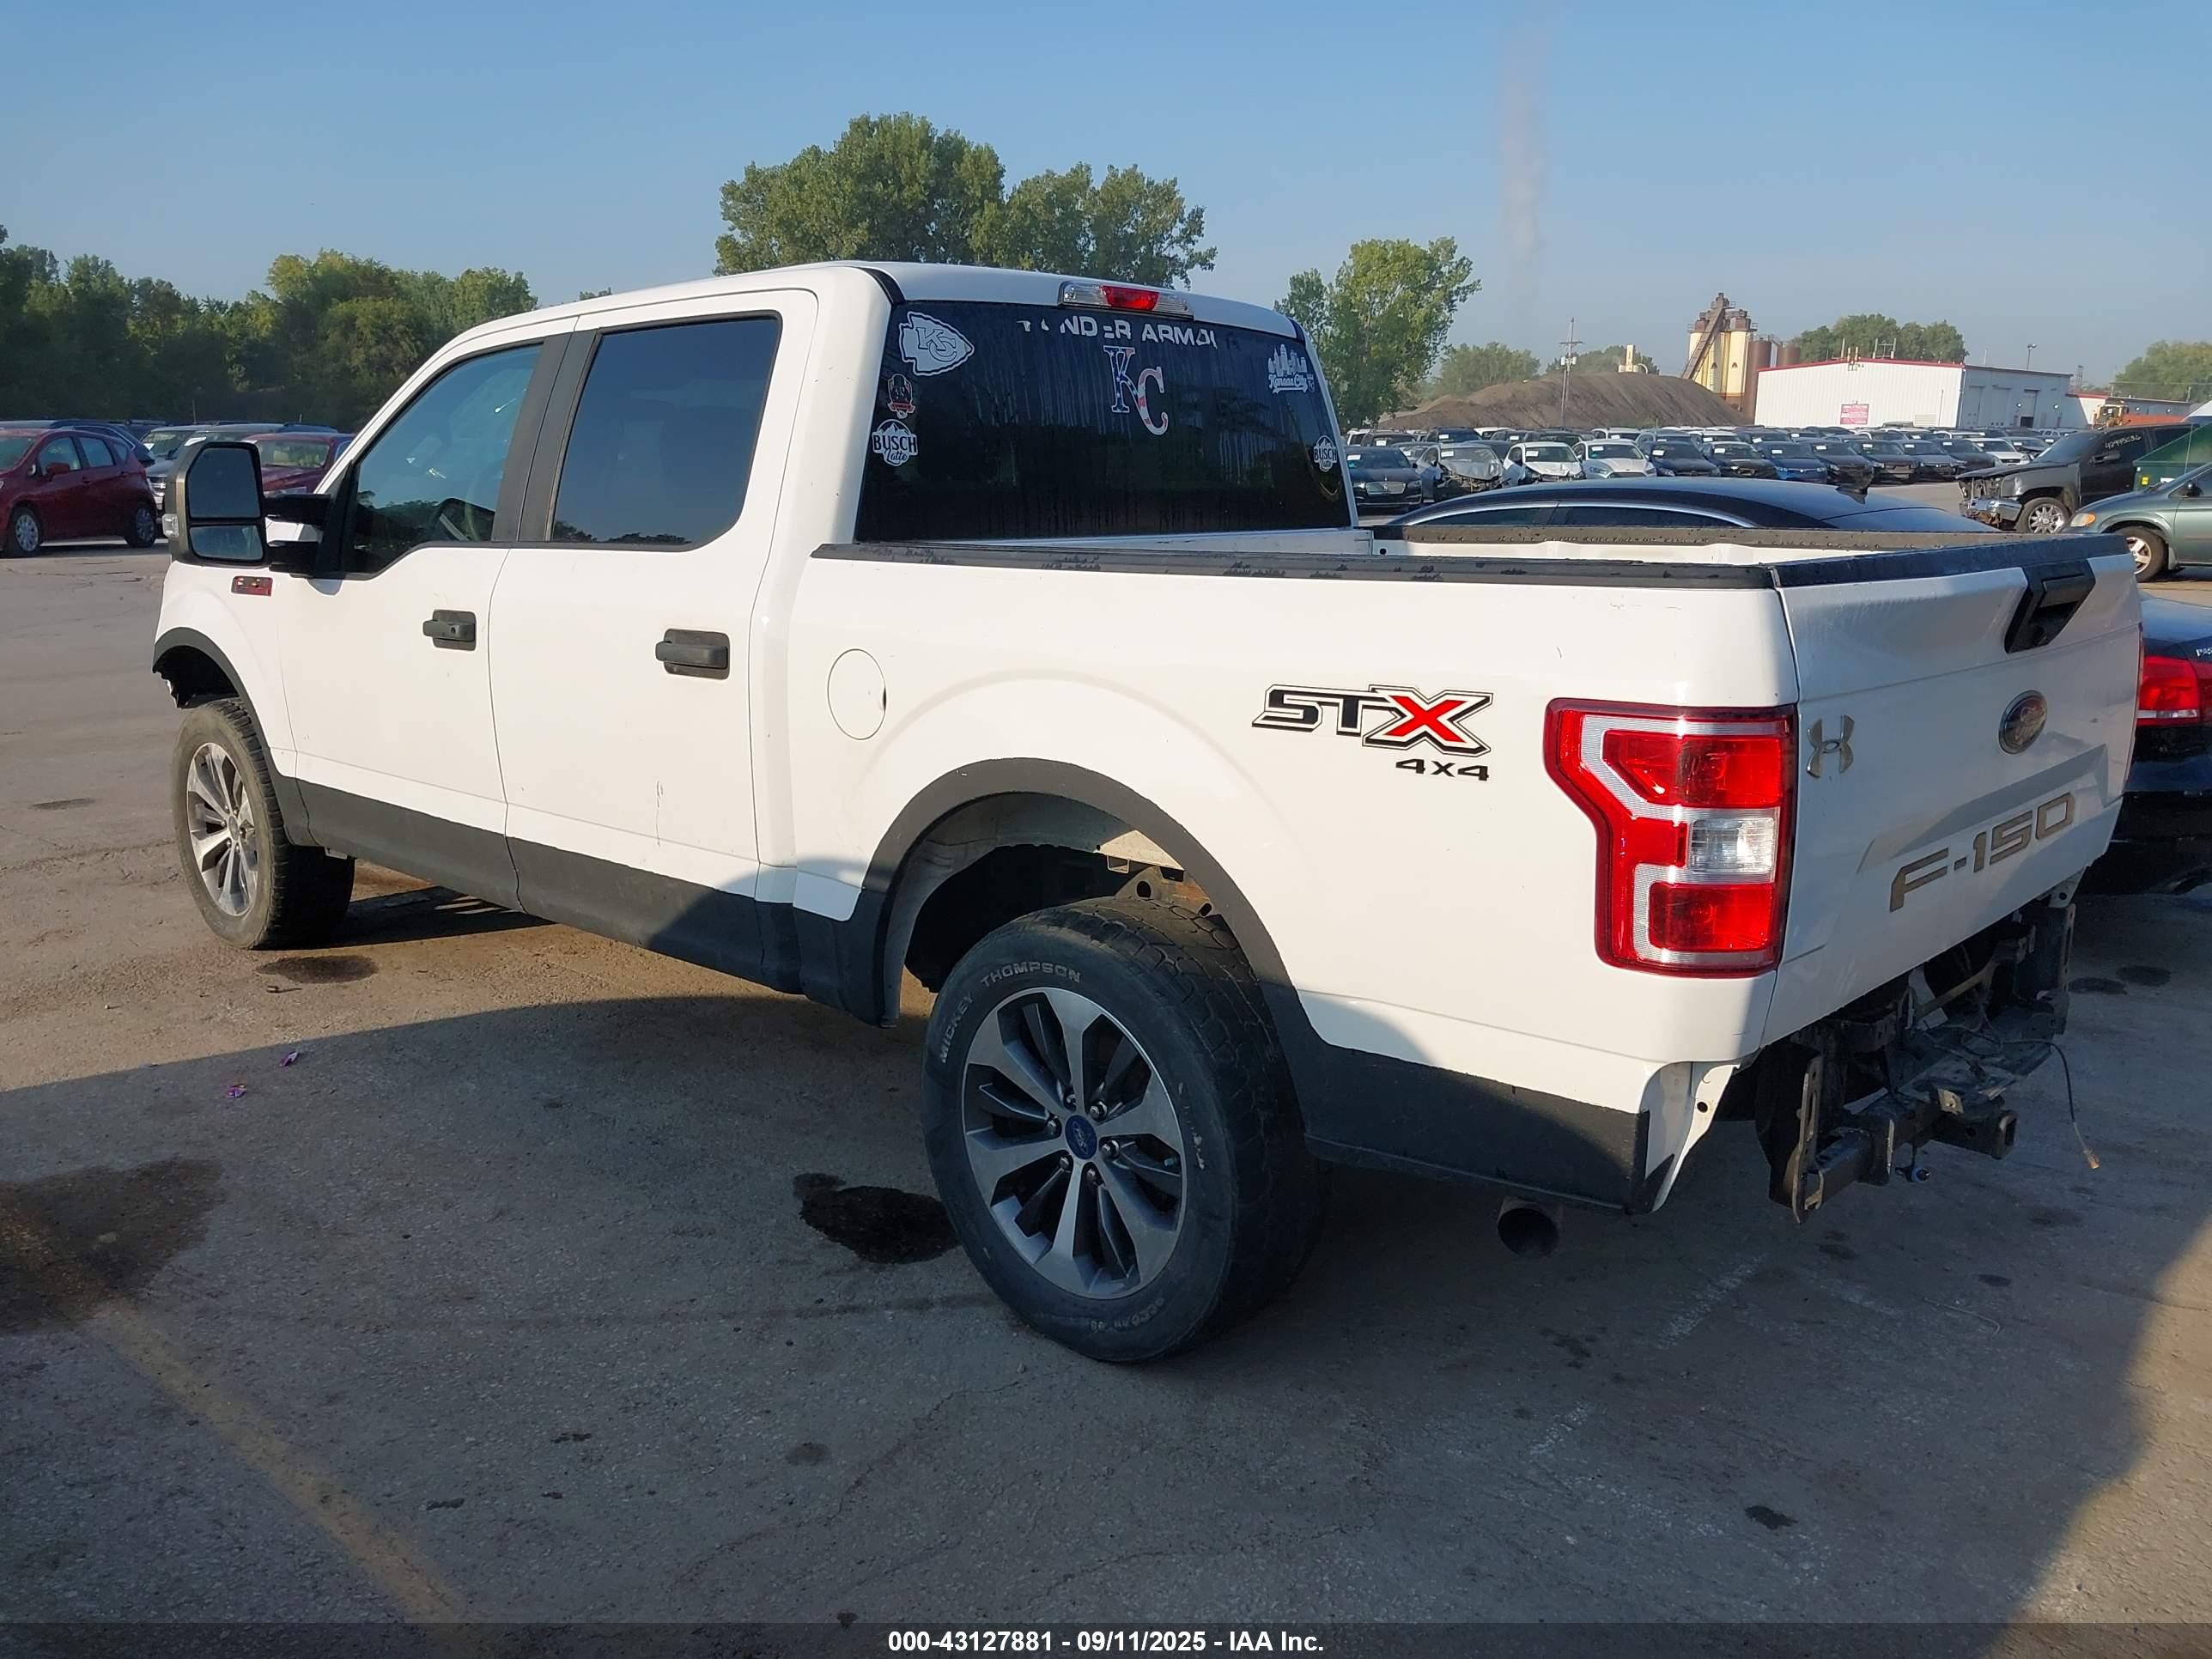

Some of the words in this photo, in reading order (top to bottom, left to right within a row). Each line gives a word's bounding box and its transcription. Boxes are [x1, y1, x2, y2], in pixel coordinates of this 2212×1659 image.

[915, 327, 957, 362] KC
[1103, 345, 1168, 435] KC
[873, 434, 917, 453] BUSCH
[884, 448, 908, 463] Latte
[1314, 447, 1337, 461] BUSCH
[1252, 684, 1493, 757] STX
[1890, 792, 2075, 913] F-150
[939, 990, 975, 1064] MICKEY
[980, 961, 1082, 988] THOMPSON
